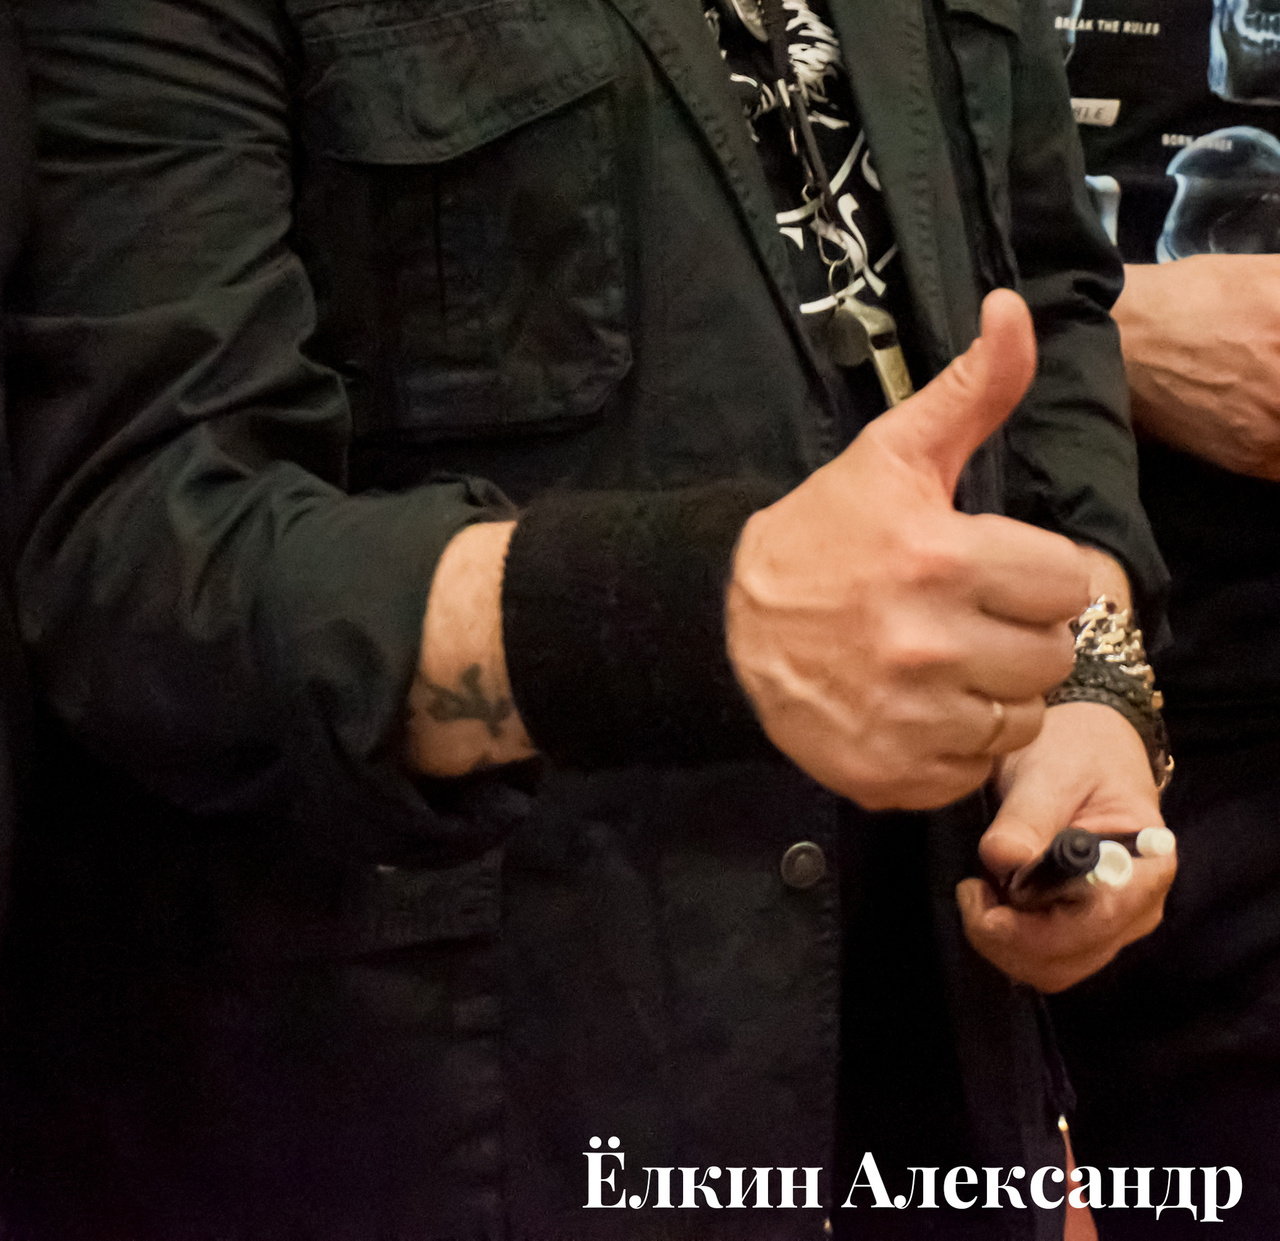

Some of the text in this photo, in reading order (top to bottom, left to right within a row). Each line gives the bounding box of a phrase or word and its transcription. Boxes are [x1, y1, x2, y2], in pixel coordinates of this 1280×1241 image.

[1055, 16, 1160, 35] BREAK THE RULES
